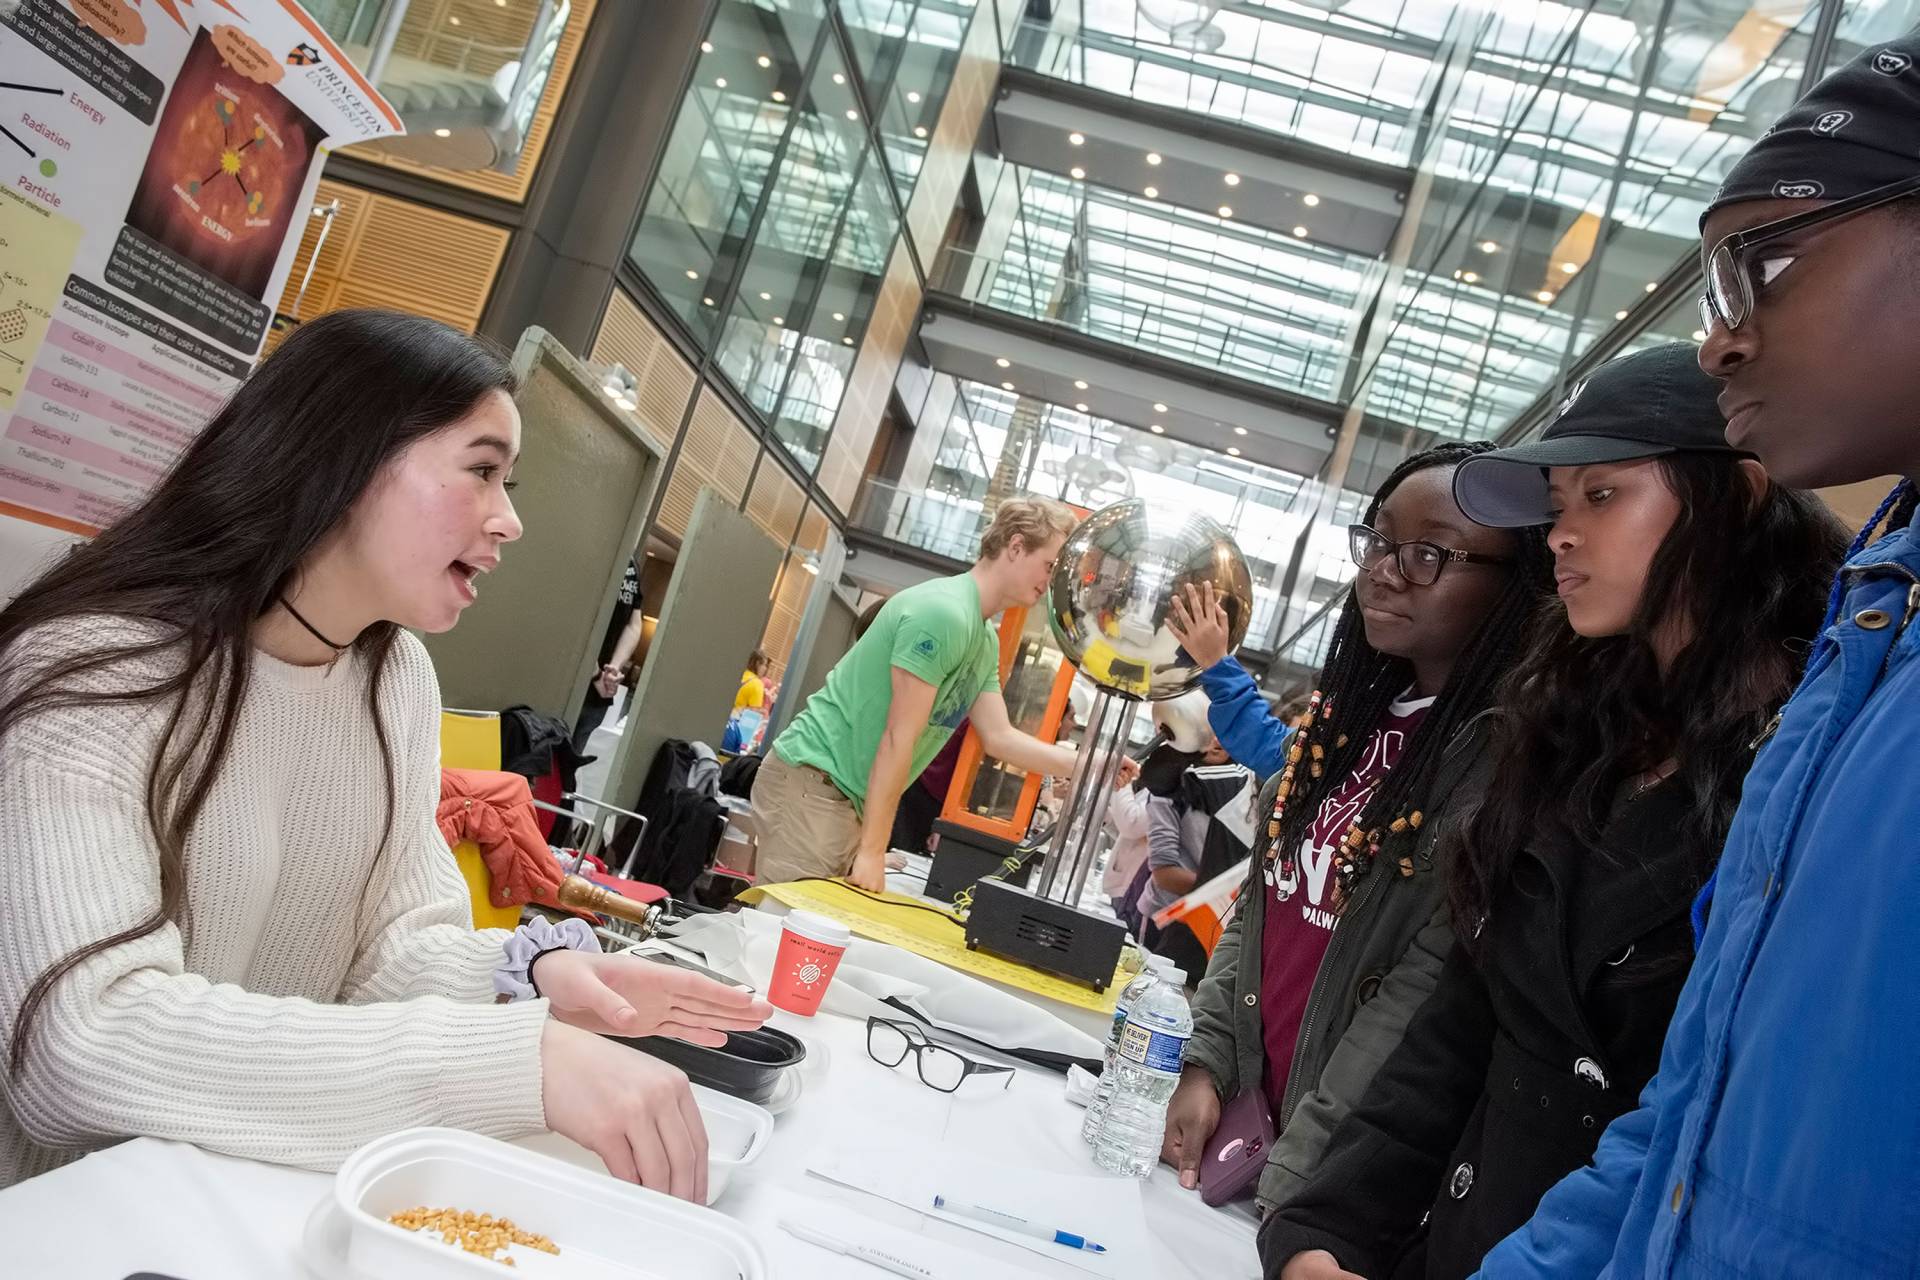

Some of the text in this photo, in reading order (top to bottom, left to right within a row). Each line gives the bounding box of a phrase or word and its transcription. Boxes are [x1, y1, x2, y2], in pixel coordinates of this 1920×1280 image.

[33, 11, 92, 61] transformation
[92, 55, 102, 68] to
[102, 63, 122, 83] other
[53, 10, 75, 31] when
[75, 27, 108, 56] unstable
[108, 48, 131, 73] nuclei
[17, 18, 36, 37] and
[36, 29, 58, 53] large
[57, 48, 92, 78] amounts
[92, 73, 103, 84] of
[101, 79, 128, 104] energy
[69, 91, 107, 126] Energy
[305, 70, 374, 136] UNIVERSITY
[318, 65, 386, 133] PRINCETON
[20, 112, 72, 151] Radiation
[17, 175, 62, 208] Particle
[122, 230, 135, 244] The
[147, 245, 162, 260] and
[62, 300, 104, 327] Radioactive
[66, 280, 108, 309] Common
[106, 300, 143, 328] Isotopes
[142, 319, 159, 334] and
[158, 326, 178, 343] their
[176, 335, 194, 352] uses
[201, 349, 237, 373] medicine
[51, 378, 89, 400] Carbon-14
[42, 401, 80, 423] Carbon-11
[31, 424, 73, 446] Sodium-24
[807, 944, 827, 955] world
